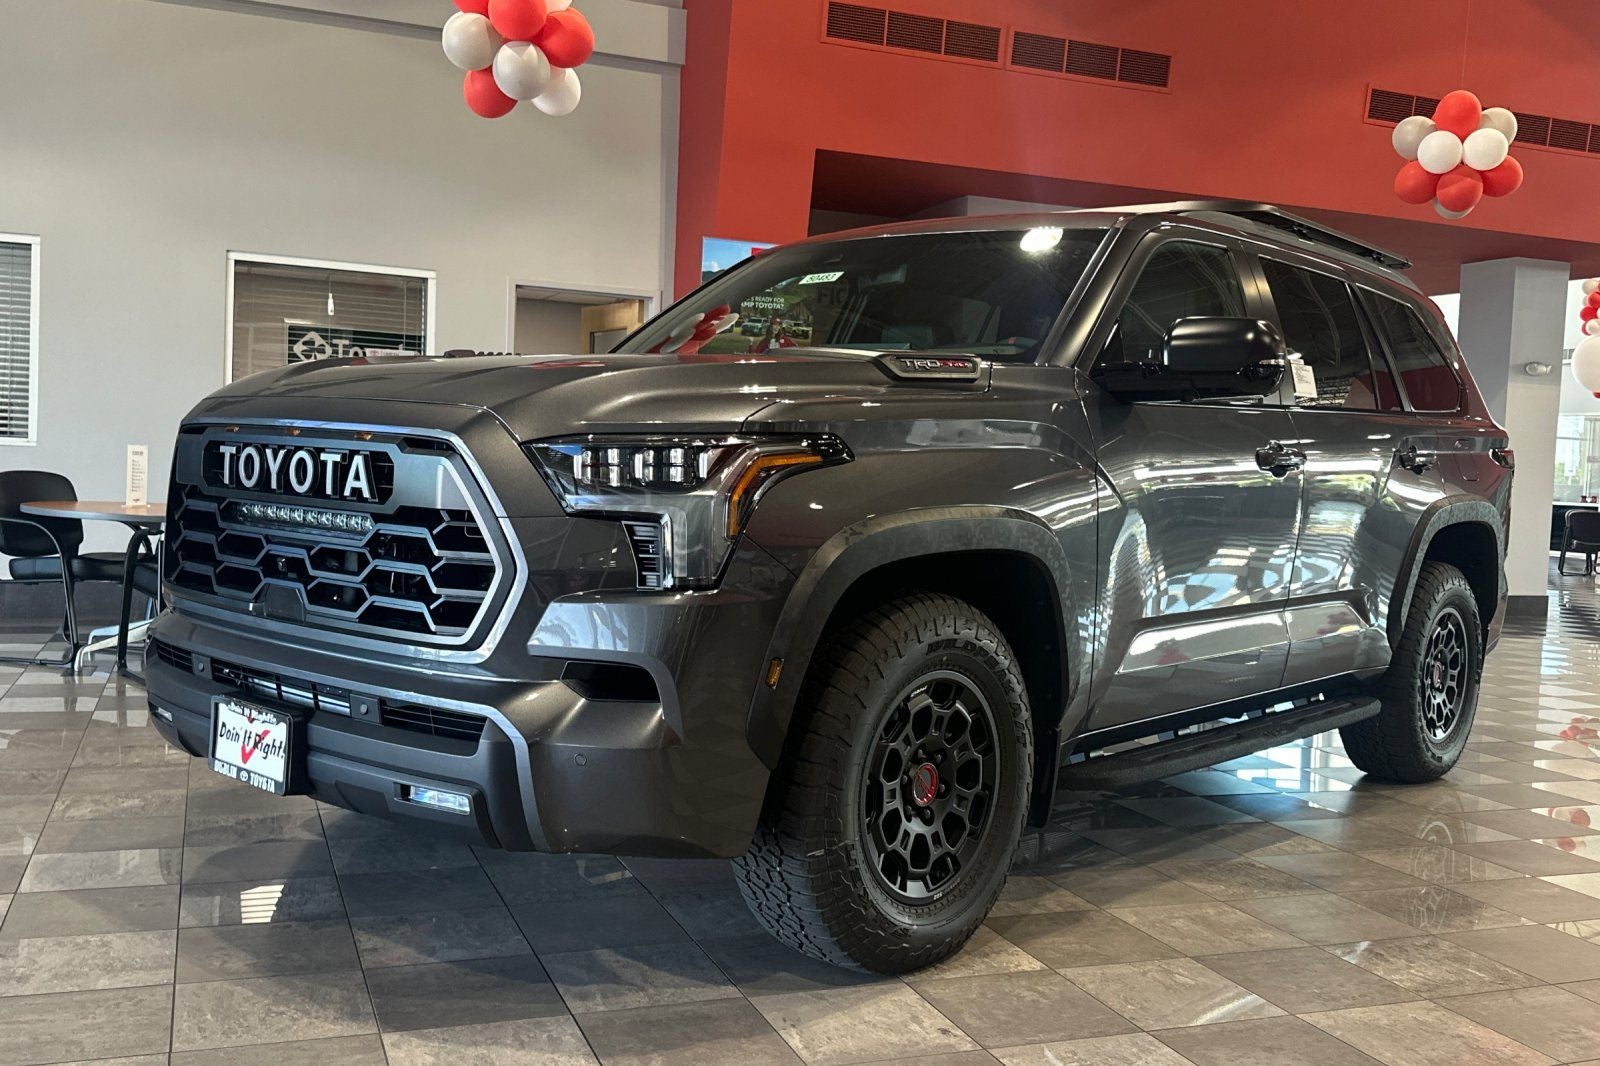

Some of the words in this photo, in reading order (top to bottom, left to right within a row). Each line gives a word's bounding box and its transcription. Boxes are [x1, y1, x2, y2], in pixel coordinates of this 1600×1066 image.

[900, 358, 940, 369] TRD
[219, 444, 373, 499] TOYOTA
[242, 729, 252, 747] It
[249, 772, 275, 793] TOYOTA
